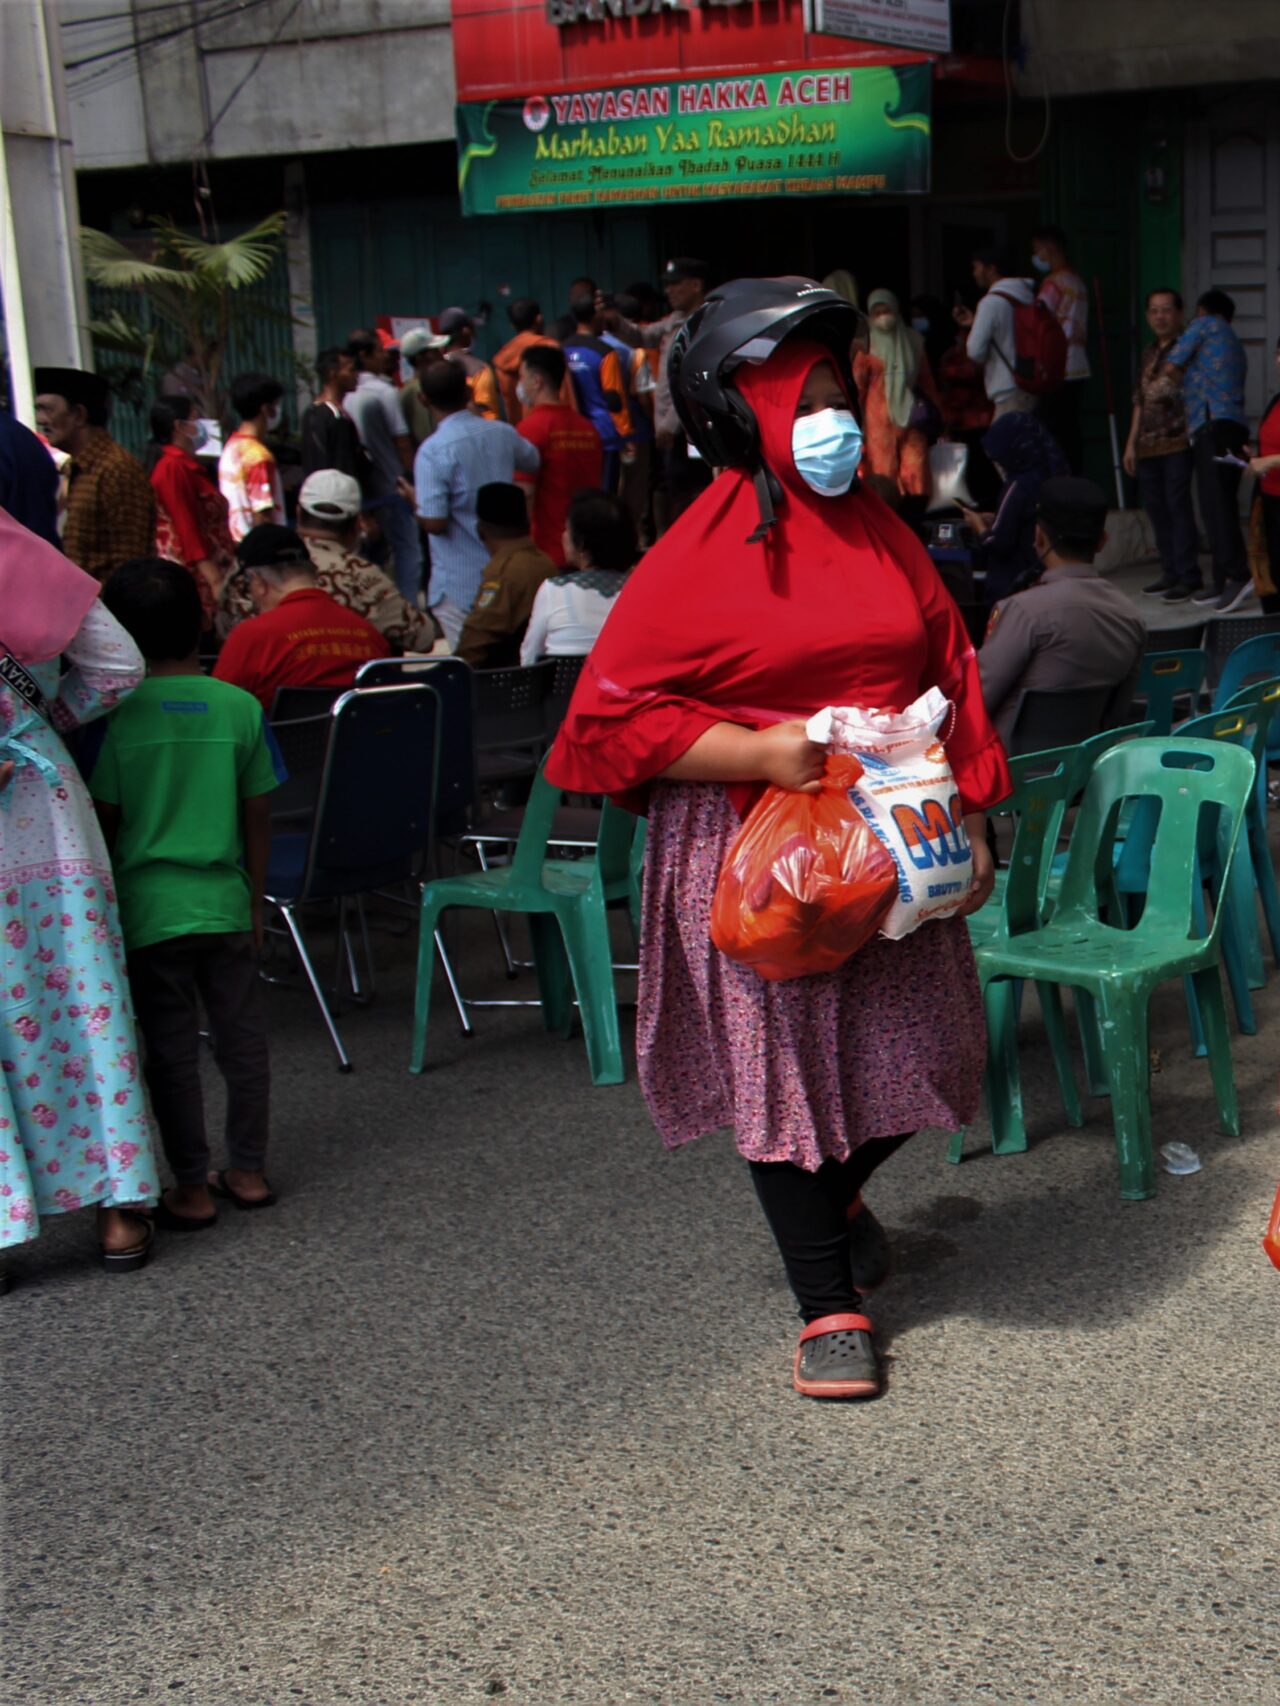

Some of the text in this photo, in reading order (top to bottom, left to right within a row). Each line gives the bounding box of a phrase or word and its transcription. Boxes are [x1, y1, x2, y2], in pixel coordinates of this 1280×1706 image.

[551, 72, 851, 124] YAYASAN HAKKA ACEH
[535, 111, 836, 160] Marhaban Yaa Ramadhan
